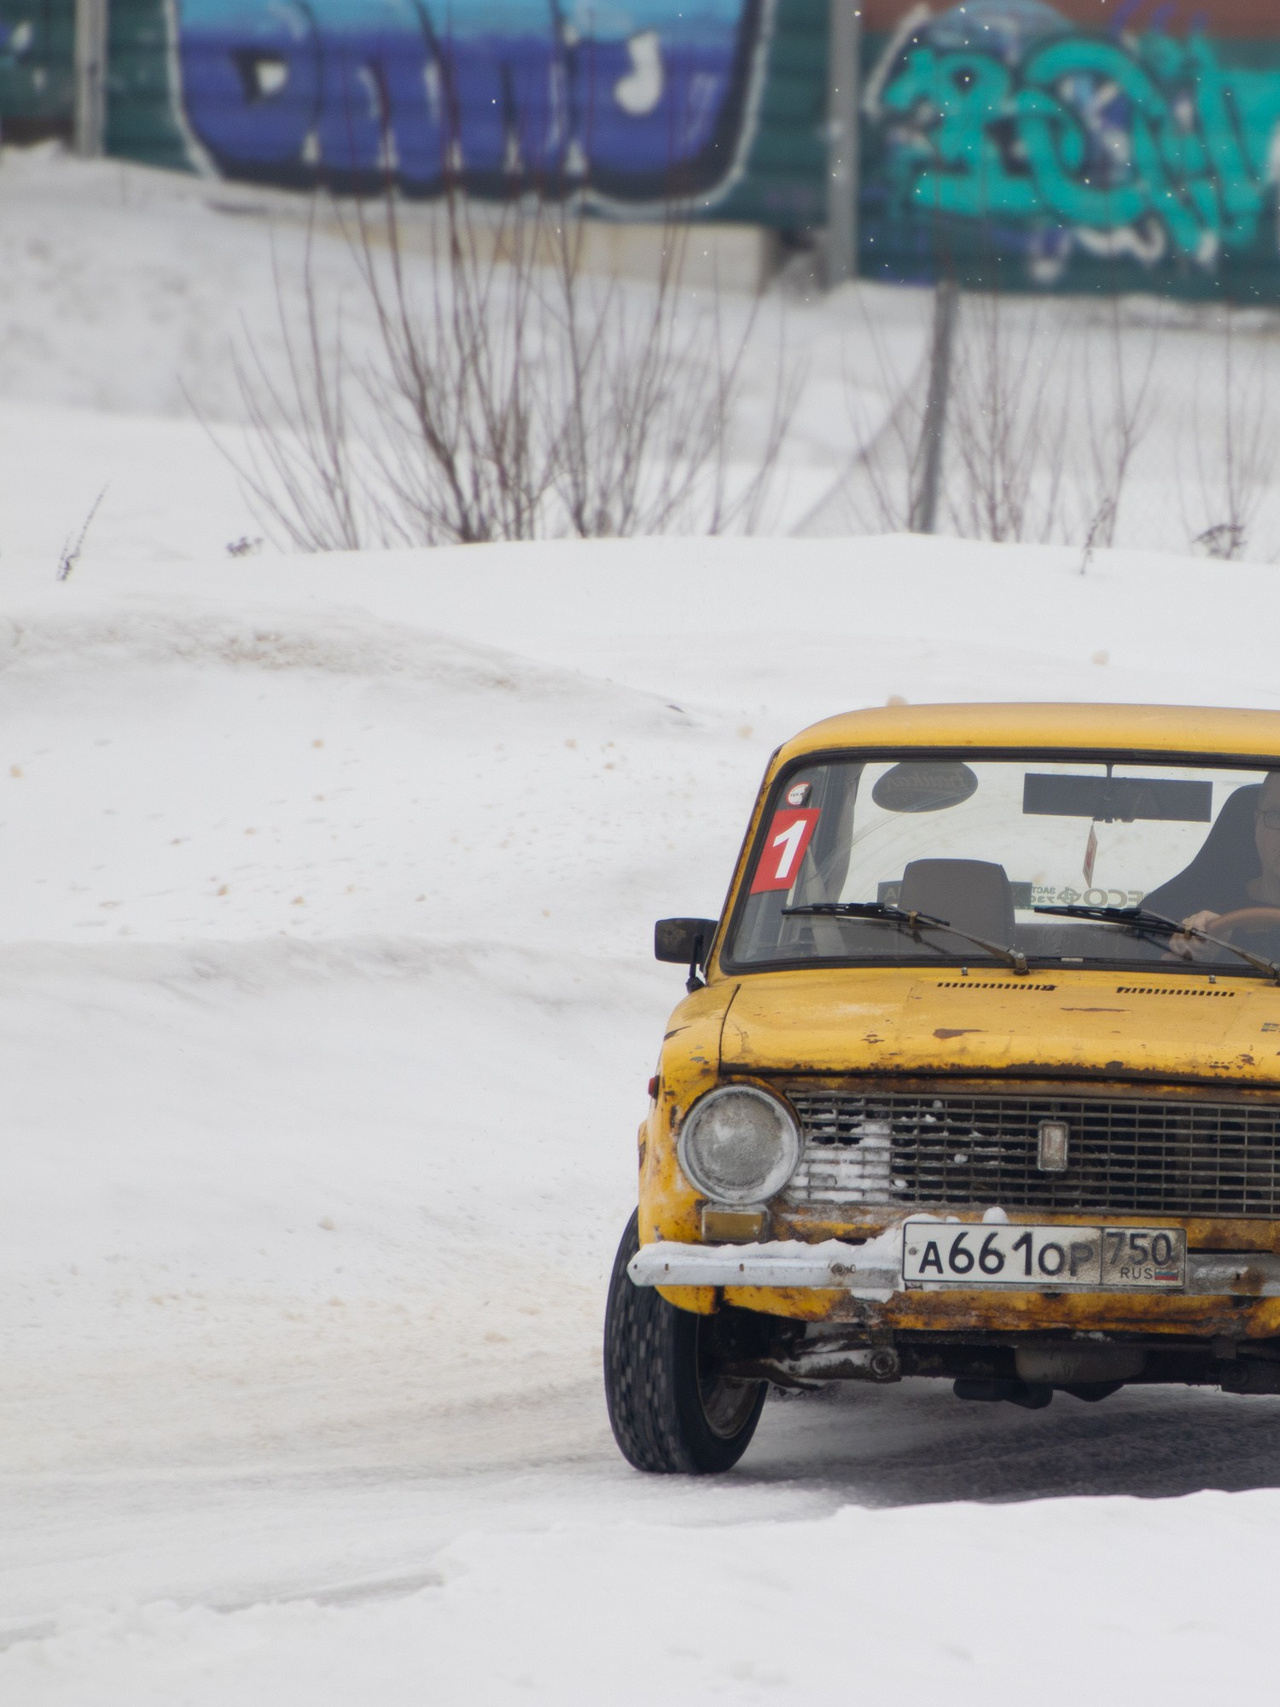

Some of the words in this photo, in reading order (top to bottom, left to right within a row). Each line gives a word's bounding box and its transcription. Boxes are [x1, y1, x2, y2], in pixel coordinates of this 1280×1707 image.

[772, 820, 807, 879] 1
[1105, 1231, 1172, 1266] 750
[1119, 1267, 1153, 1280] RUS
